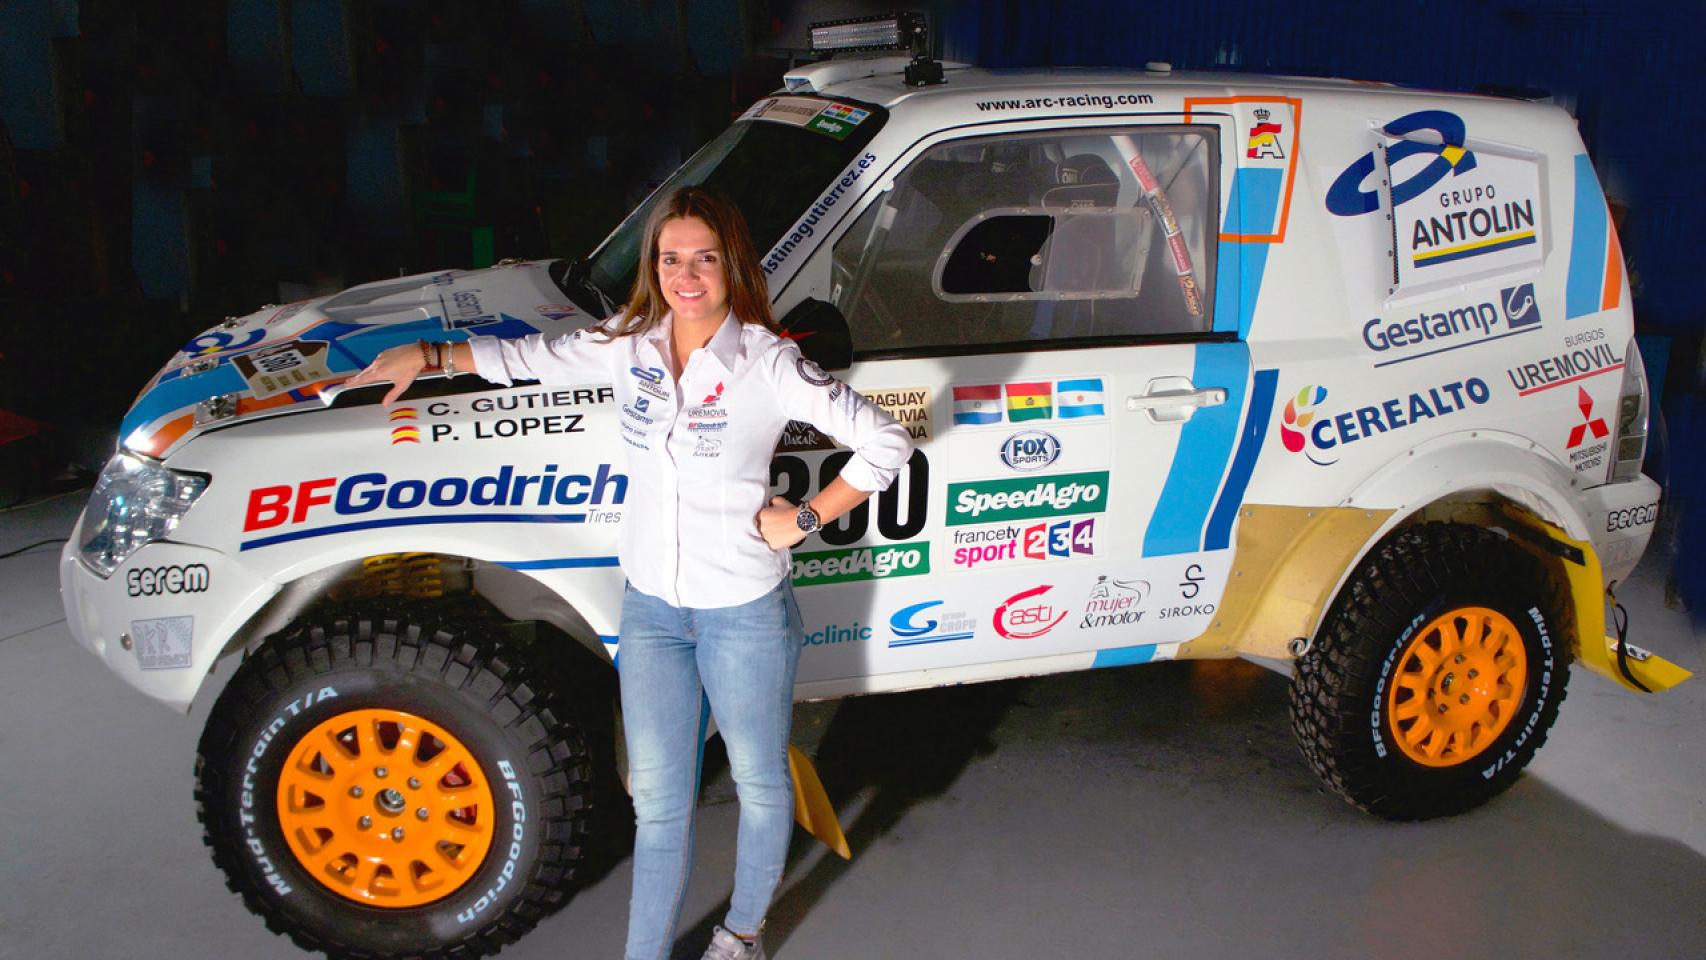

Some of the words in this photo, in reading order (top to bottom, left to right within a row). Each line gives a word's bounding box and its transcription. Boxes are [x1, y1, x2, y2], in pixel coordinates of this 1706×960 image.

[976, 94, 1154, 112] www.arc-racing.com
[1440, 185, 1496, 208] GRUPO
[1412, 199, 1535, 250] ANTOLIN
[1363, 302, 1498, 351] Gestamp
[1565, 328, 1606, 348] BURGOS
[1508, 342, 1624, 391] UREMOVIL
[428, 402, 460, 416] C.
[1310, 377, 1490, 450] CEREALTO
[432, 424, 460, 442] P.
[475, 415, 585, 440] LOPEZ
[1013, 438, 1049, 457] FOX
[1013, 454, 1049, 464] SPORTS
[1569, 441, 1607, 464] MITSUBISHI
[1575, 456, 1602, 473] MOTORS
[243, 464, 629, 533] BFGoodrich
[955, 482, 1101, 517] SpeedAgro
[588, 508, 622, 524] Tires
[954, 539, 1017, 568] sport
[127, 563, 210, 597] serem
[1009, 604, 1053, 626] asti
[1085, 593, 1136, 613] mujer
[1158, 603, 1216, 620] SIROKO
[1079, 610, 1147, 630] &motor
[1371, 612, 1426, 759] BFGoodrich
[1515, 605, 1555, 747] Mud-Terrain
[1481, 750, 1517, 780] T/A
[240, 716, 293, 896] Mud-Terrain
[285, 685, 339, 716] T/A
[456, 759, 526, 924] BFGoodrich
